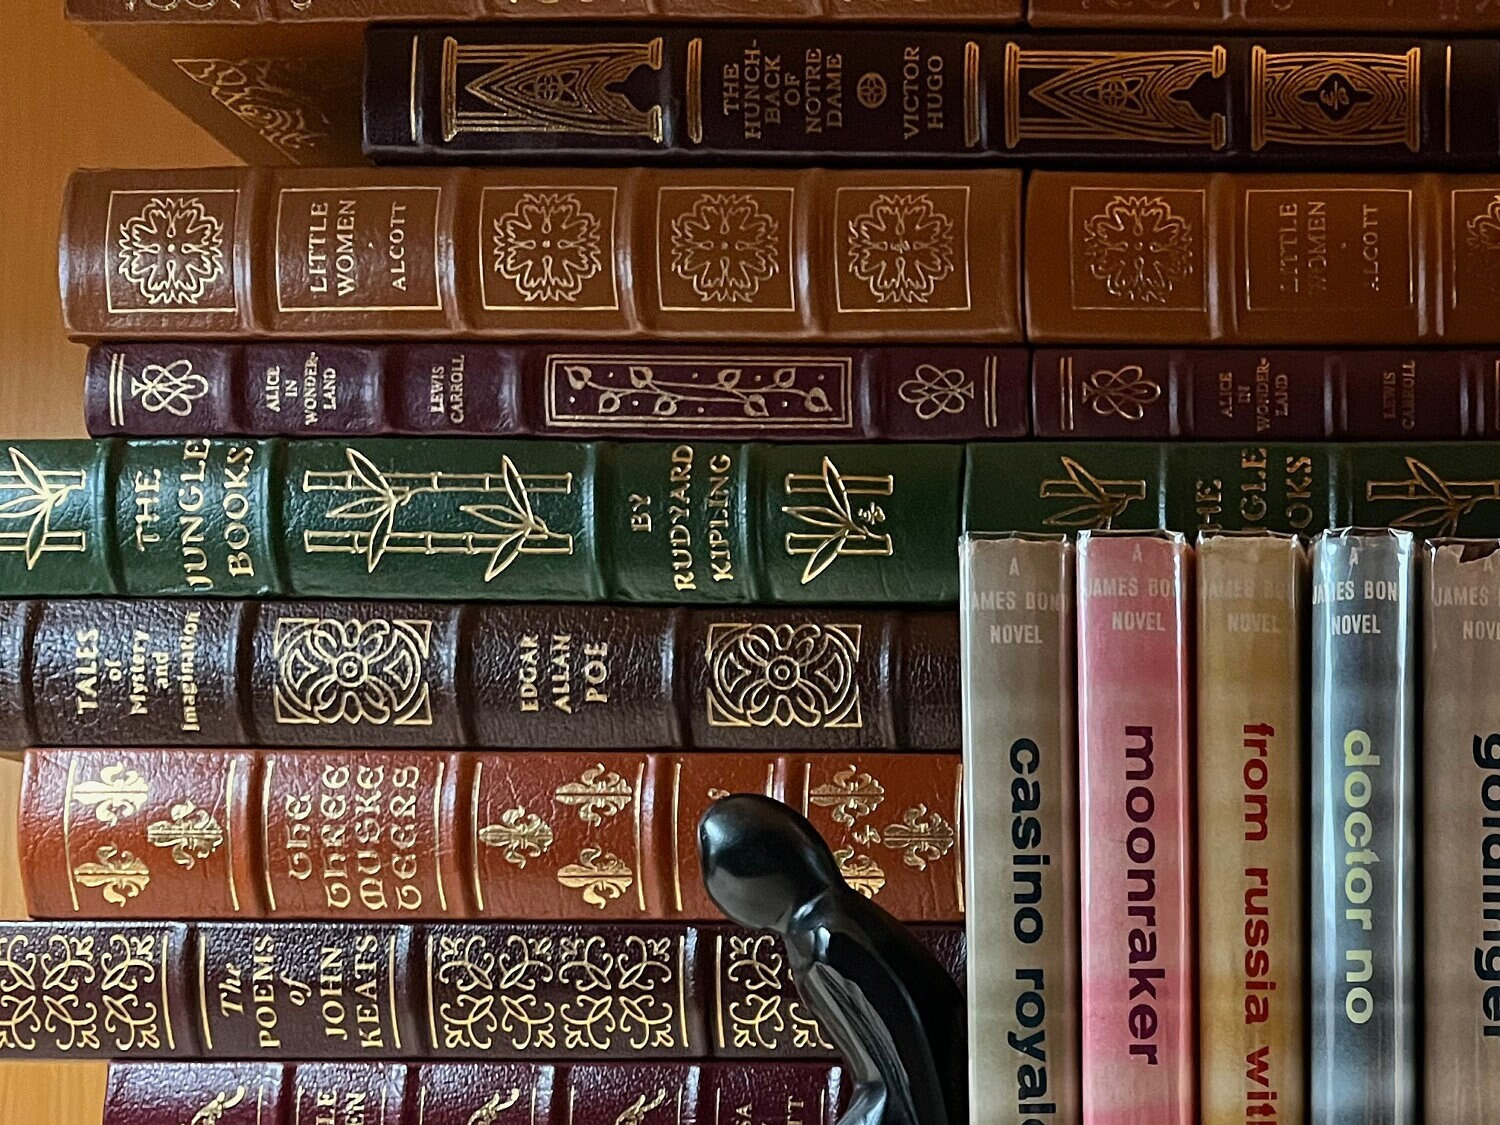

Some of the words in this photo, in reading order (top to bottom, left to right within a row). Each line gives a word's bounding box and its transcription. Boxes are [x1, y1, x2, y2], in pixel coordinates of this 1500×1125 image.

[723, 63, 739, 115] THE
[764, 54, 781, 124] BACK
[784, 72, 800, 106] OF
[805, 48, 822, 133] NOTRE
[826, 53, 842, 128] DAME
[903, 46, 920, 140] VICTOR
[927, 55, 943, 129] HUGO
[308, 201, 329, 293] LITTLE
[335, 200, 356, 296] WOMEN
[389, 201, 407, 291] ALCOTT
[265, 365, 281, 412] ALICE
[285, 379, 298, 398] IN
[323, 367, 336, 410] LAND
[430, 366, 445, 413] LEWIS
[450, 354, 465, 424] CARROLL
[135, 468, 161, 552] THE
[178, 438, 214, 592] JUNGLE
[222, 446, 254, 577] BOOKS
[629, 493, 652, 532] BY
[669, 444, 697, 592] RUDYARD
[708, 453, 734, 582] KIPLING
[990, 625, 1043, 644] NOVEL
[1112, 611, 1166, 632] NOVEL
[1227, 613, 1280, 633] NOVEL
[1331, 614, 1381, 635] NOVEL
[1434, 587, 1489, 607] JAMES
[75, 627, 99, 715] TALES
[105, 658, 122, 682] of
[130, 630, 150, 715] Mystery
[152, 651, 169, 690] and
[520, 631, 540, 712] EDGAR
[551, 632, 573, 714] ALLAN
[583, 641, 609, 703] POE
[1242, 722, 1275, 841] from
[1010, 738, 1050, 944] casino
[1343, 730, 1380, 931] doctor
[1124, 725, 1165, 1066] moonraker
[1244, 869, 1277, 1025] russia
[218, 962, 244, 1018] The
[252, 933, 281, 1050] POEMS
[280, 971, 312, 1007] of
[319, 946, 348, 1041] JOHN
[354, 934, 384, 1049] KEATS
[1345, 949, 1373, 1024] no
